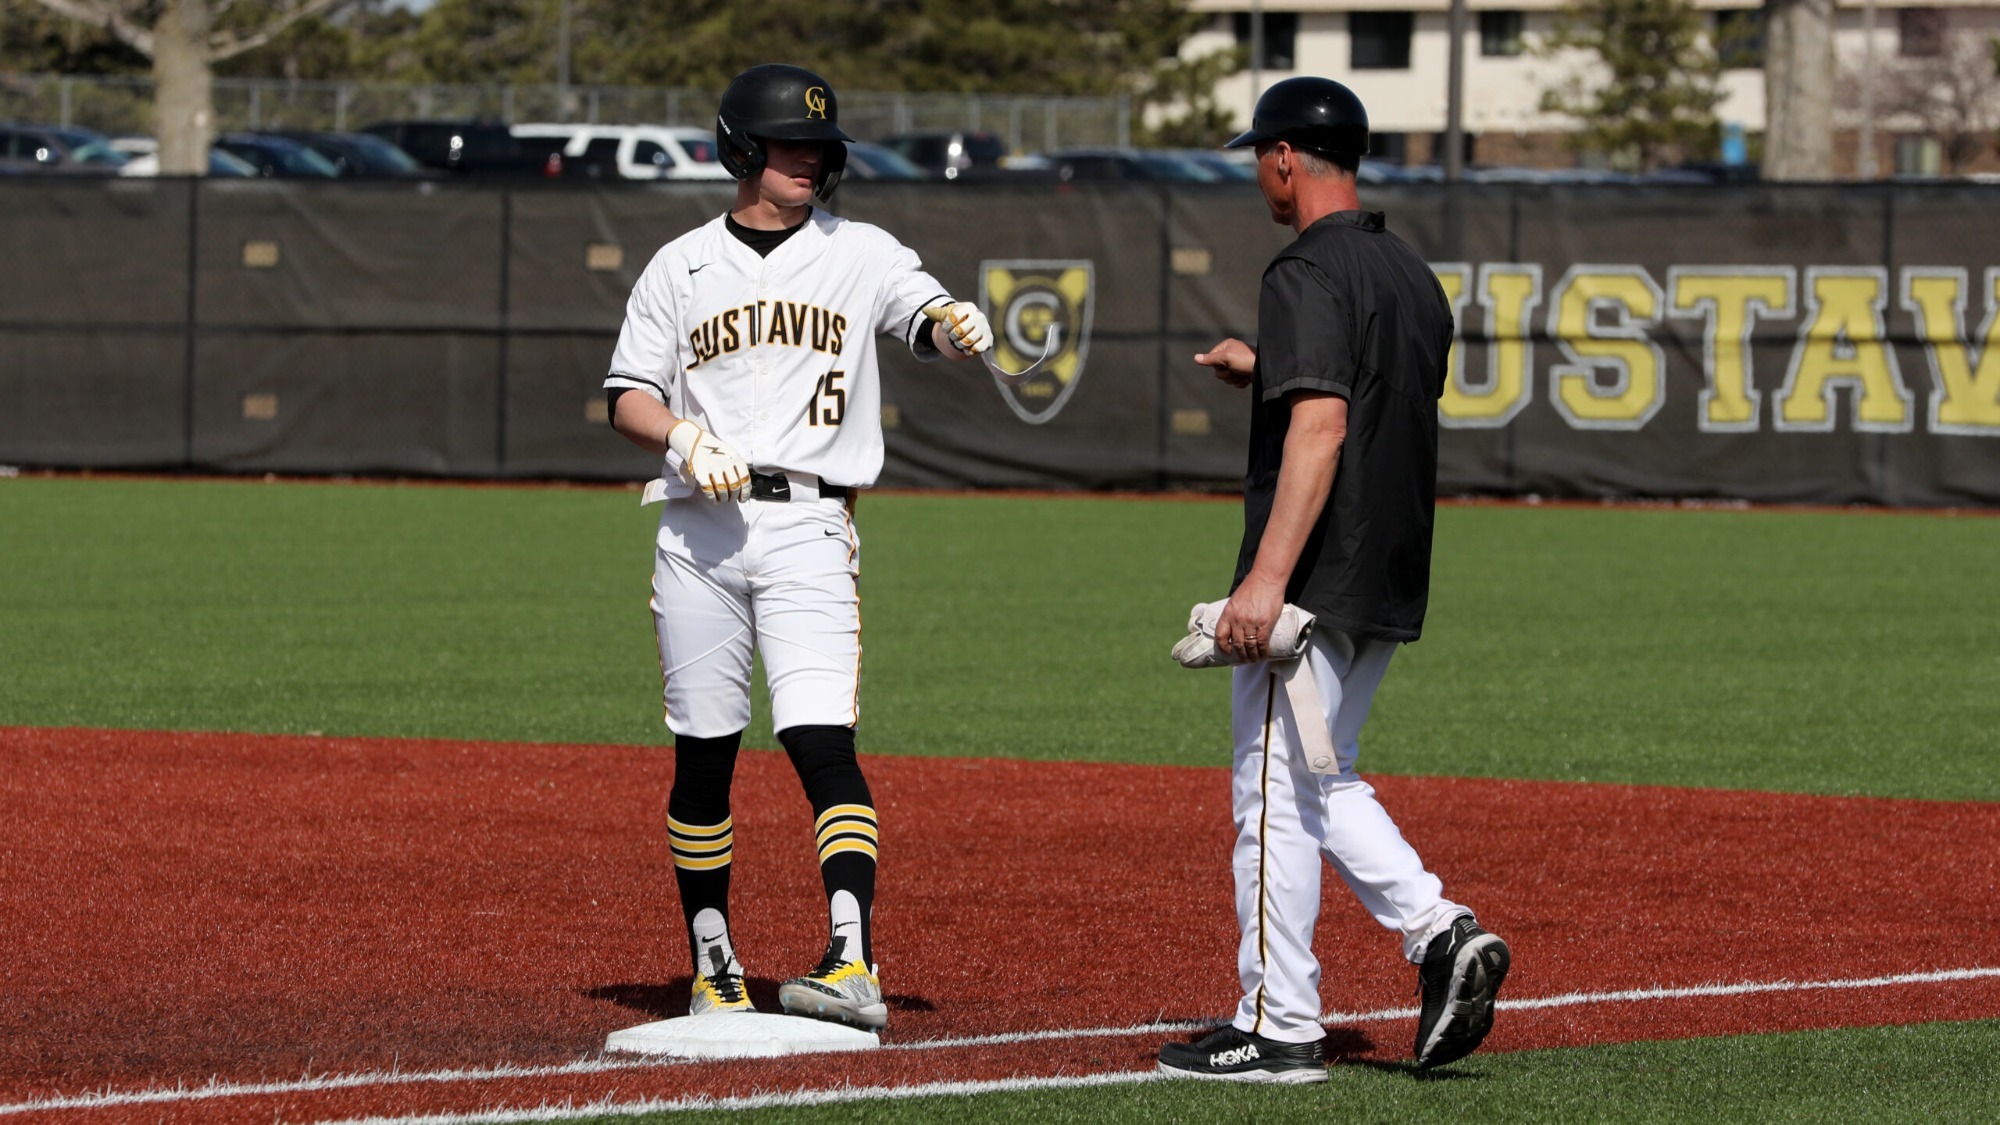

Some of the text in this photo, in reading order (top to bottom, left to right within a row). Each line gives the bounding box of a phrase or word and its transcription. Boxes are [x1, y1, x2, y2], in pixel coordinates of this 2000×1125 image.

[685, 301, 847, 370] GUSTAVUS
[1005, 291, 1061, 357] G
[808, 370, 846, 427] 15
[1210, 1044, 1260, 1067] HOKA
